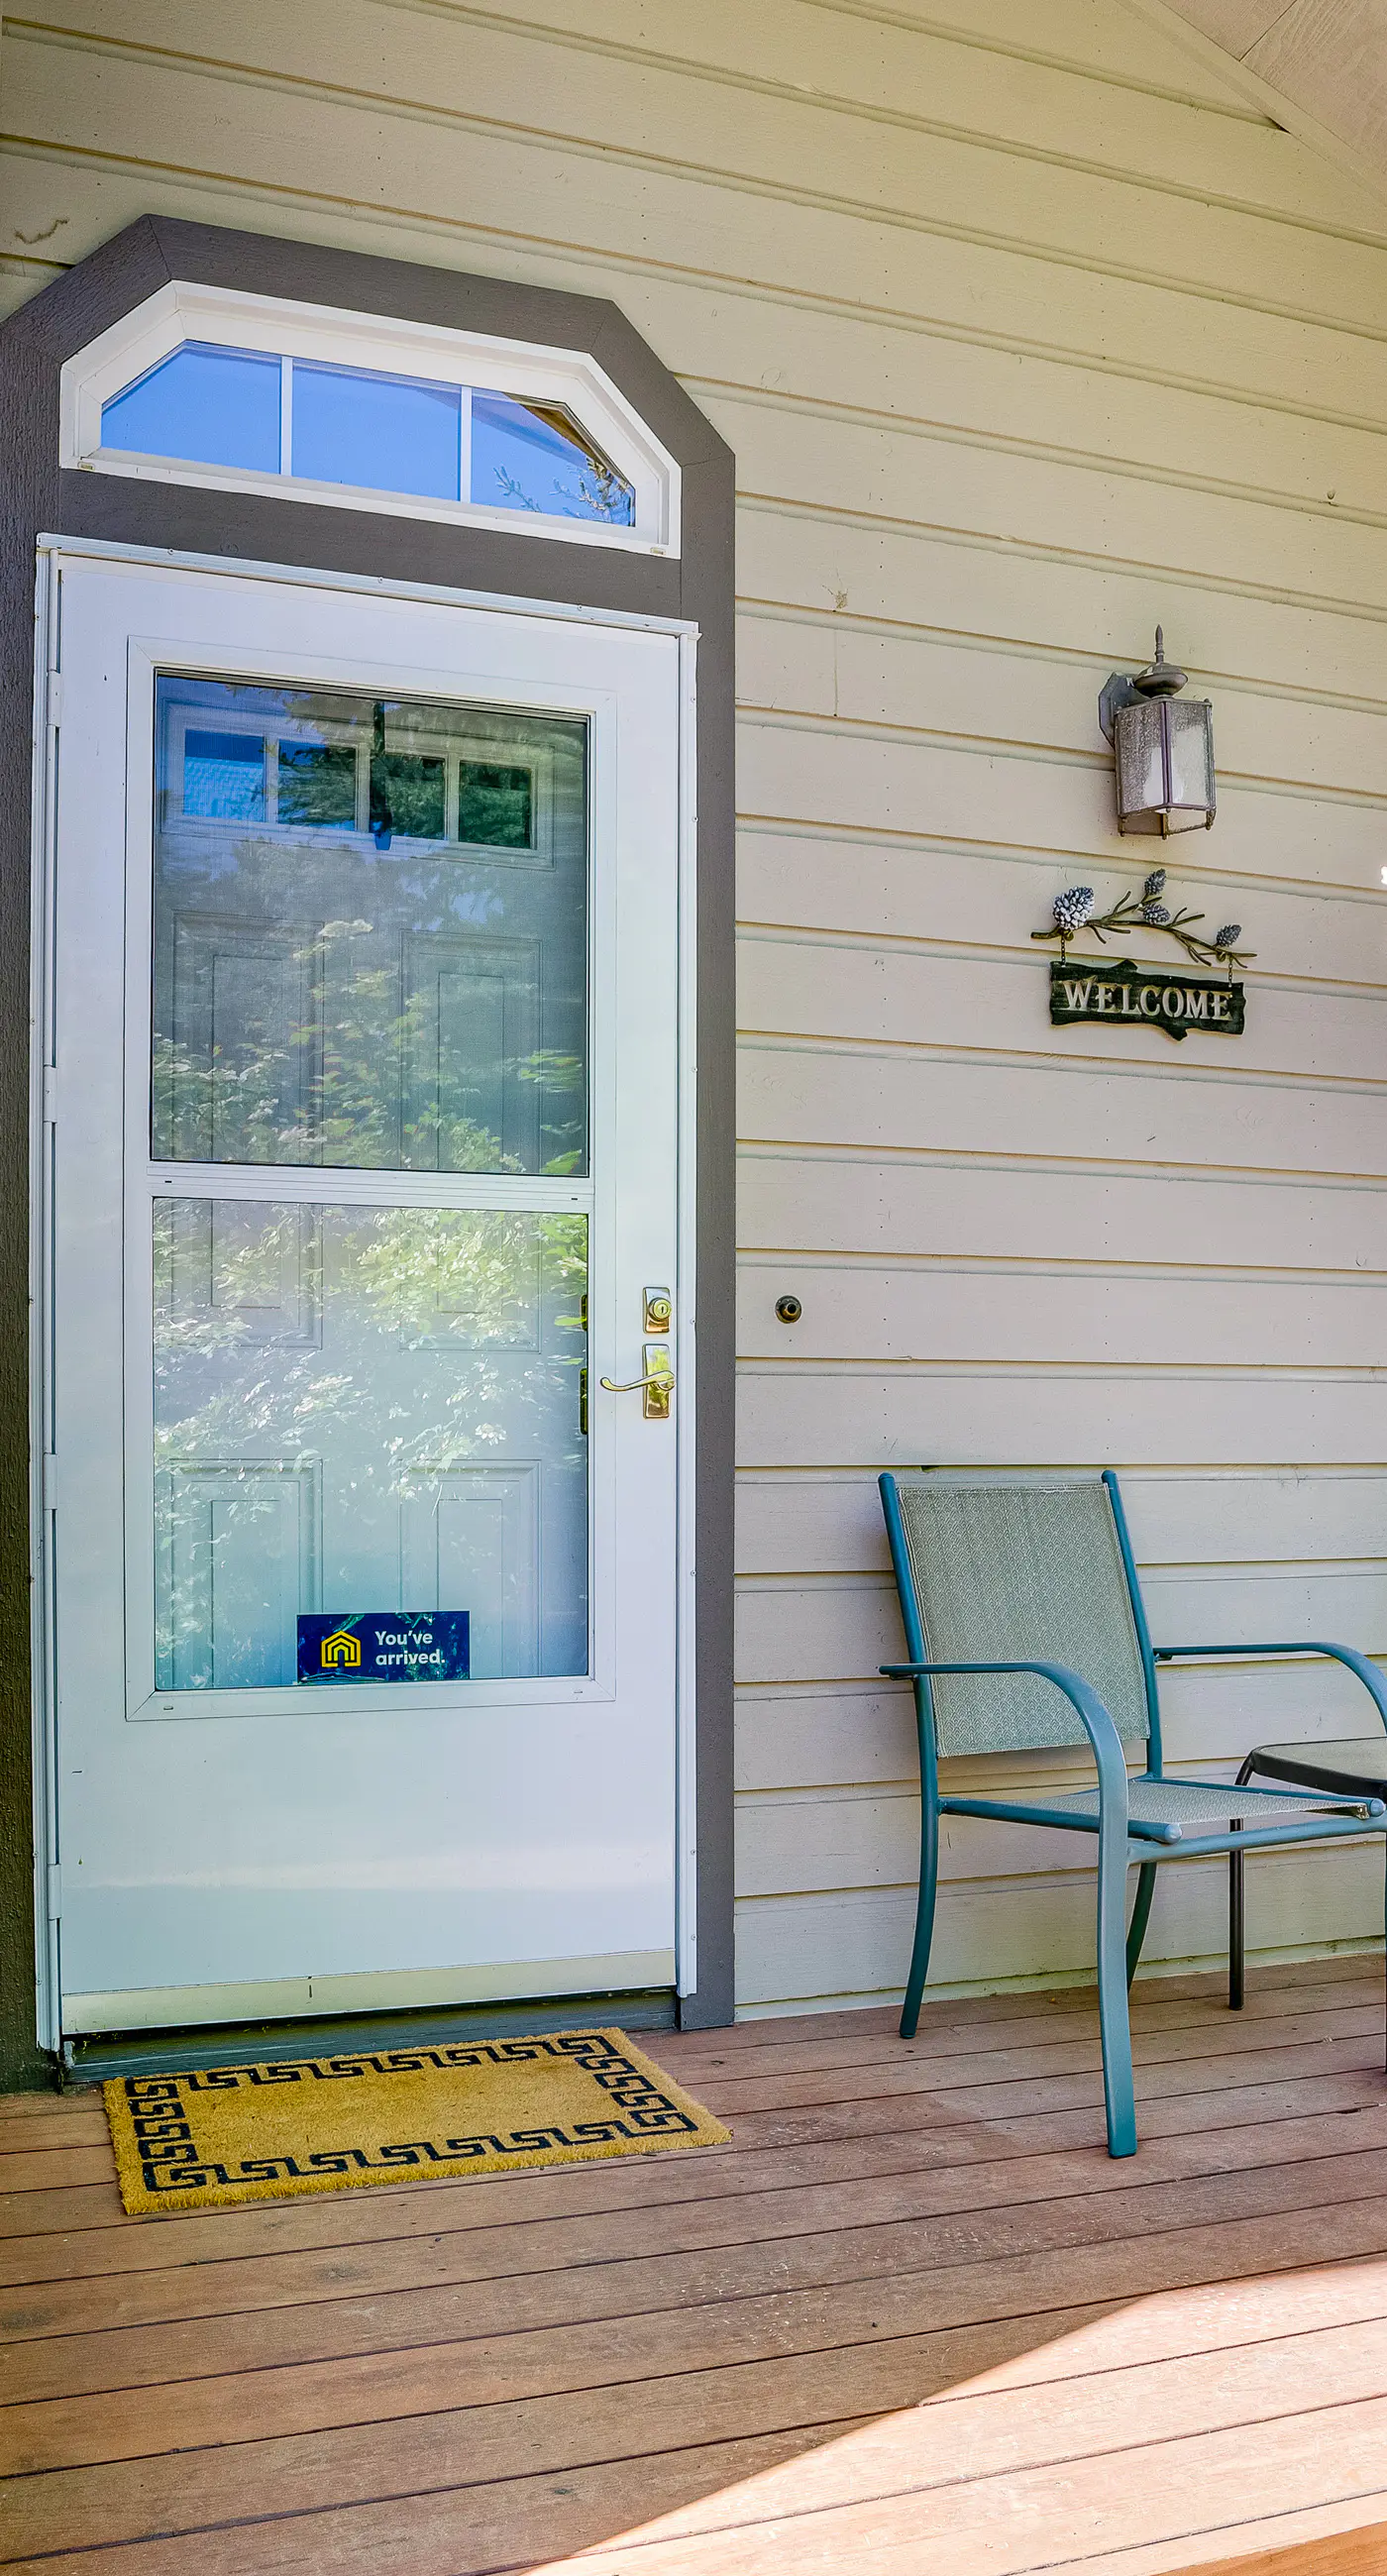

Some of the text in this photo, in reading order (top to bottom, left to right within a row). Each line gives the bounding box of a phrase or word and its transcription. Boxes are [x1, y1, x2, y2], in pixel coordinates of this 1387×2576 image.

[1062, 976, 1233, 1020] WELCOME
[374, 1630, 433, 1646] You've
[375, 1649, 446, 1665] arrived.
